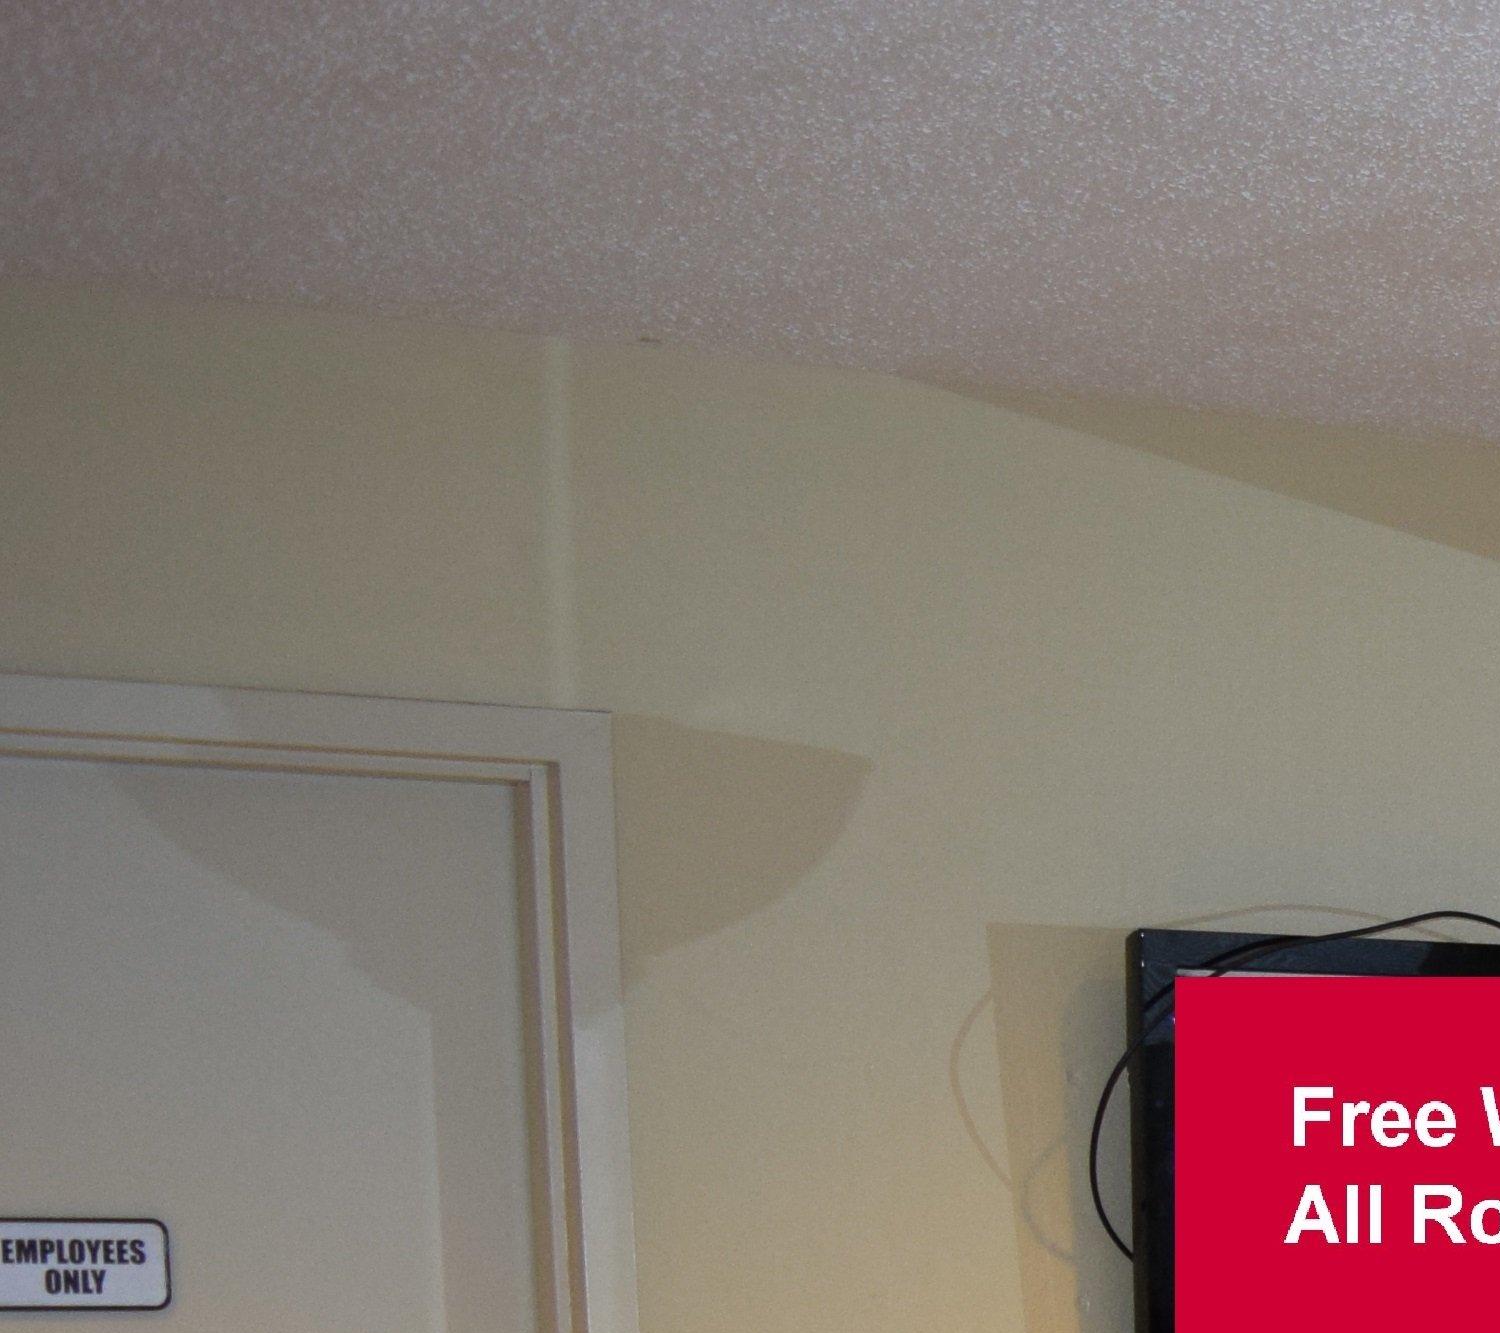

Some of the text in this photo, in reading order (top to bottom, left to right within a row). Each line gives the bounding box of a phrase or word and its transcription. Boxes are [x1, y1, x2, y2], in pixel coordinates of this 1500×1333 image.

[1294, 1087, 1456, 1147] Free
[1285, 1185, 1382, 1244] All
[1, 1239, 146, 1265] EMPLOYEES
[45, 1269, 106, 1295] ONLY
